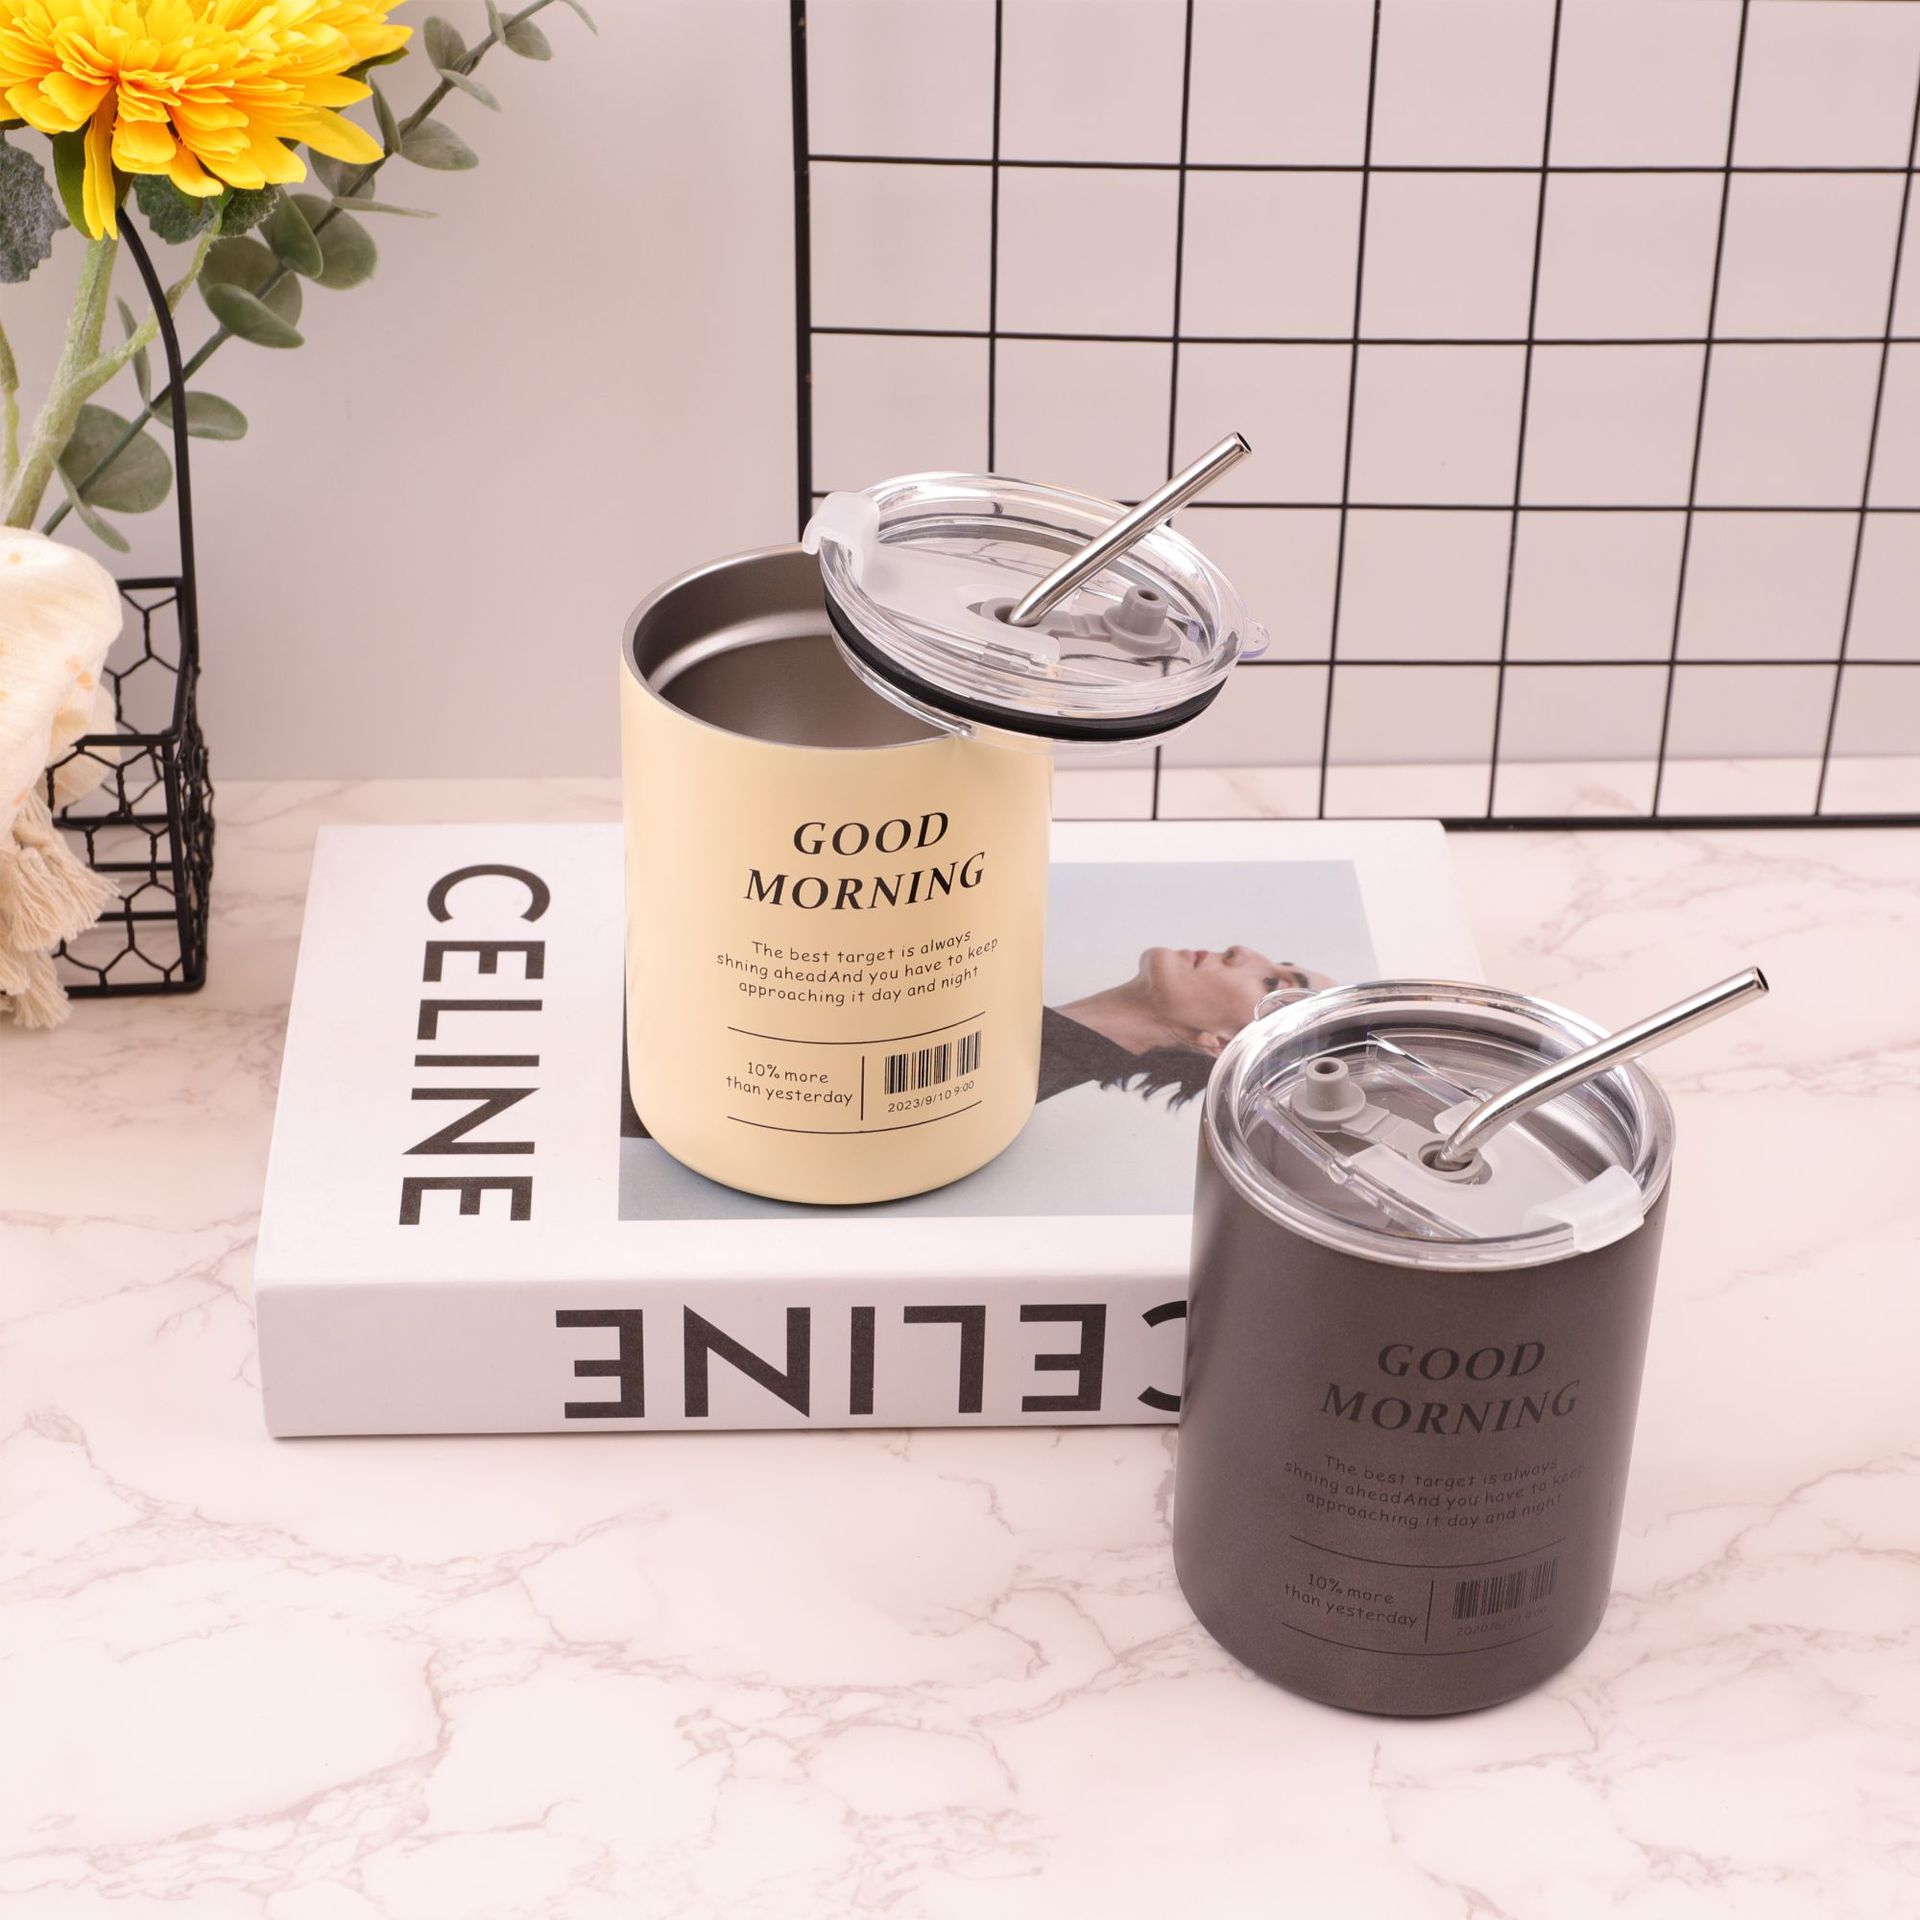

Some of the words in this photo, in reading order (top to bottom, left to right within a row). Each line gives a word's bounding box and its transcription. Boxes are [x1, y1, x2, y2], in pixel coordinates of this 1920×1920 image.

[793, 811, 949, 856] GOOD
[744, 851, 986, 911] MORNING
[716, 953, 769, 980] shning
[869, 968, 899, 985] you
[904, 960, 942, 979] have
[947, 952, 963, 966] to
[967, 937, 998, 961] keep
[752, 941, 784, 960] The
[790, 947, 830, 963] best
[837, 948, 895, 966] target
[901, 945, 915, 958] is
[920, 930, 972, 955] always
[738, 981, 846, 1007] approaching
[852, 990, 866, 1003] it
[872, 988, 902, 1004] day
[907, 980, 936, 998] and
[941, 965, 980, 991] night
[399, 863, 551, 1226] CELINE
[725, 1075, 761, 1096] than
[765, 1086, 854, 1108] yesterday
[747, 1062, 781, 1080] 10%
[784, 1070, 830, 1084] more
[888, 1089, 952, 1113] 2023/9/10
[954, 1080, 975, 1096] 9:00
[1378, 1341, 1546, 1381] GOOD
[1320, 1379, 1581, 1435] MORNING
[1283, 1461, 1340, 1494] shning
[1446, 1494, 1479, 1510] you
[1484, 1486, 1526, 1504] have
[1531, 1481, 1547, 1495] to
[1324, 1454, 1358, 1476] The
[1364, 1465, 1406, 1486] best
[1414, 1474, 1476, 1491] target
[1483, 1472, 1498, 1485] is
[1503, 1457, 1559, 1483] always
[1305, 1490, 1420, 1530] approaching
[1426, 1515, 1440, 1527] it
[1447, 1512, 1479, 1528] day
[1485, 1507, 1517, 1524] and
[1521, 1491, 1564, 1516] night
[1285, 1583, 1321, 1607] than
[1325, 1601, 1418, 1627] yesterday
[1307, 1573, 1342, 1594] 10%
[1346, 1585, 1395, 1604] more
